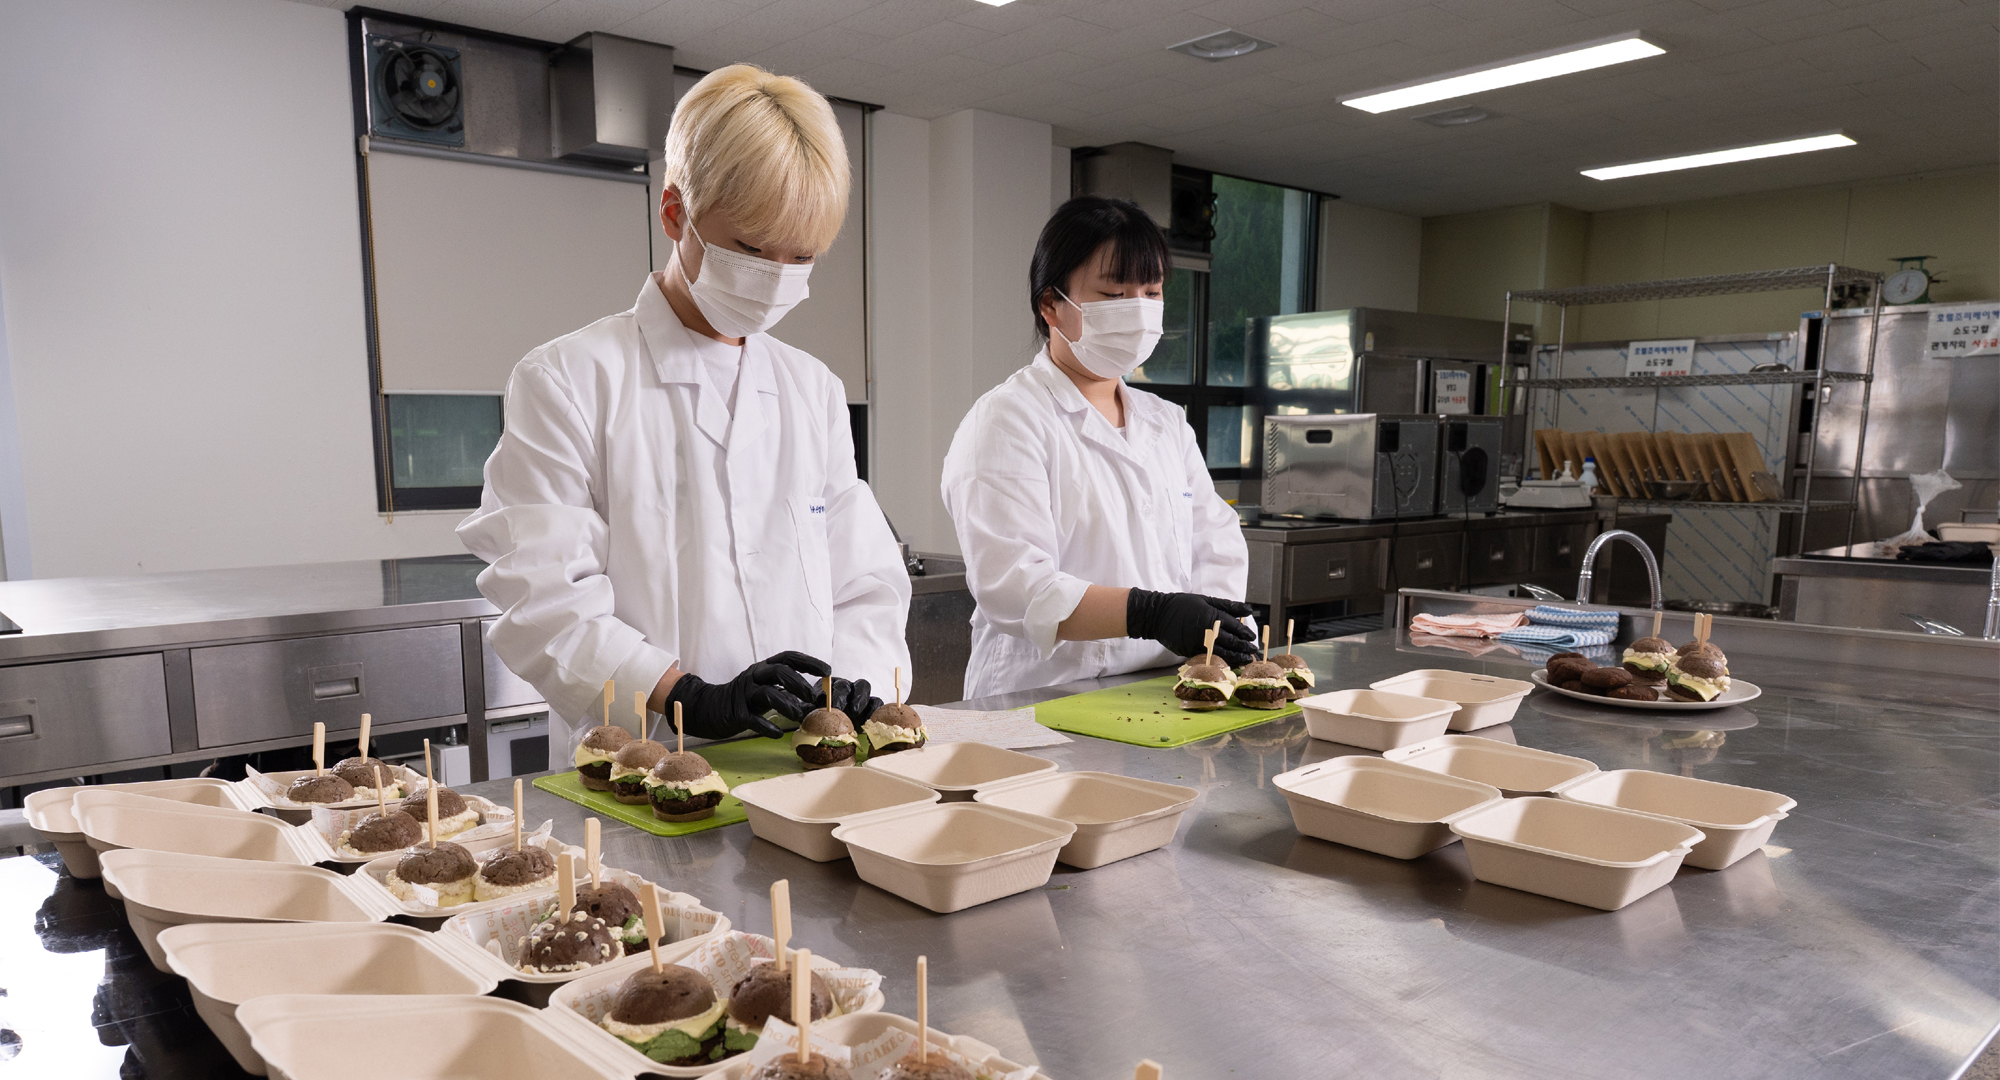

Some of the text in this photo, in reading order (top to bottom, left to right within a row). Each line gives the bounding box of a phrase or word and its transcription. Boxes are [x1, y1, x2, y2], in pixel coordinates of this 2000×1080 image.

[1937, 311, 2000, 322] 호텔조리베이커
[1972, 338, 2000, 348] 사용금
[863, 1036, 899, 1065] CAKE
